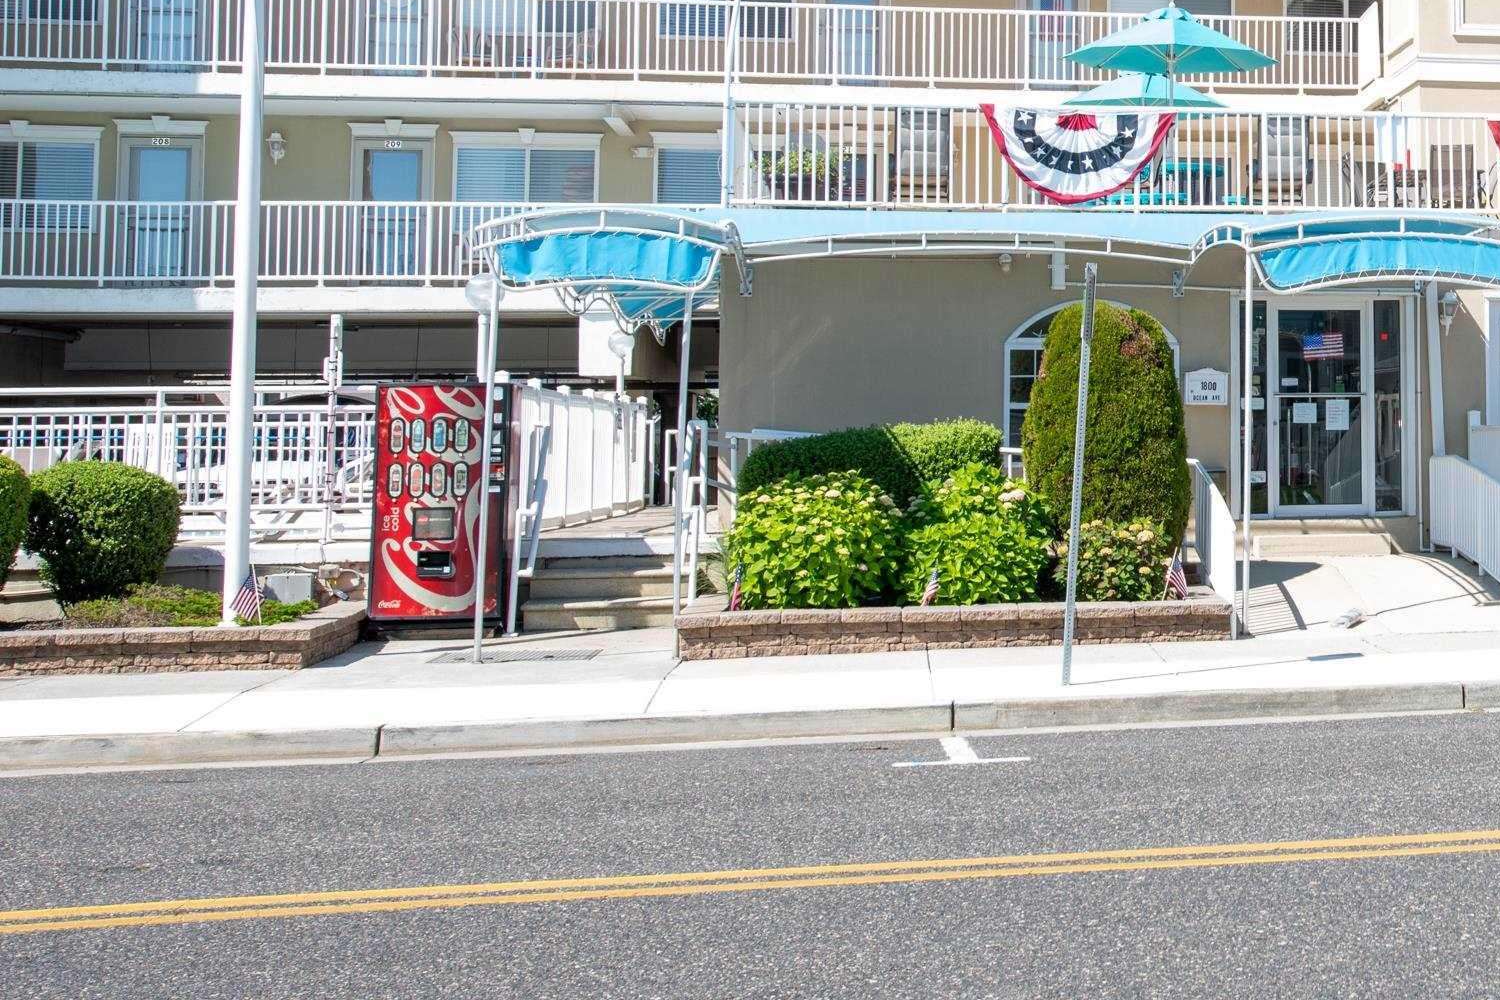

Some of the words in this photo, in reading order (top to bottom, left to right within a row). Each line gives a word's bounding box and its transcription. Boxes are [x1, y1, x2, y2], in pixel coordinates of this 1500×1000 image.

[1201, 381, 1217, 391] 1800
[382, 515, 390, 531] ice
[390, 507, 399, 531] cold
